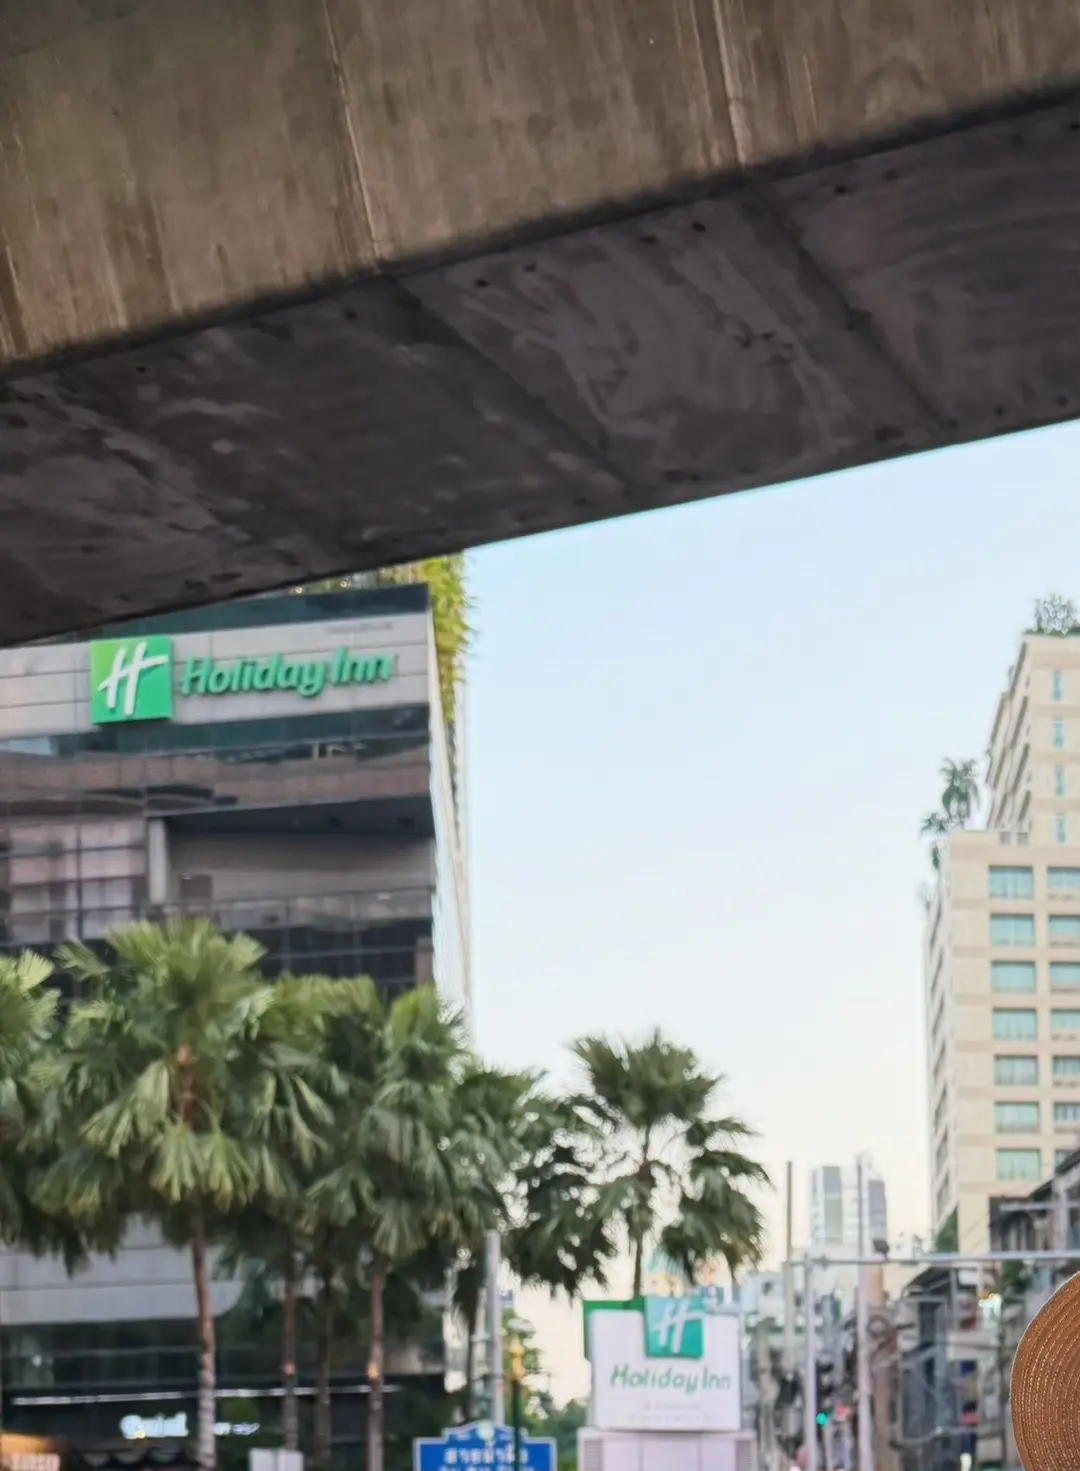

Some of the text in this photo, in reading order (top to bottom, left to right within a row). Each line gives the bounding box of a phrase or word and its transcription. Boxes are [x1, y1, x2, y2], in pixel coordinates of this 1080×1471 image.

[180, 646, 393, 697] Holiday Inn
[610, 1363, 732, 1397] Holiday Inn
